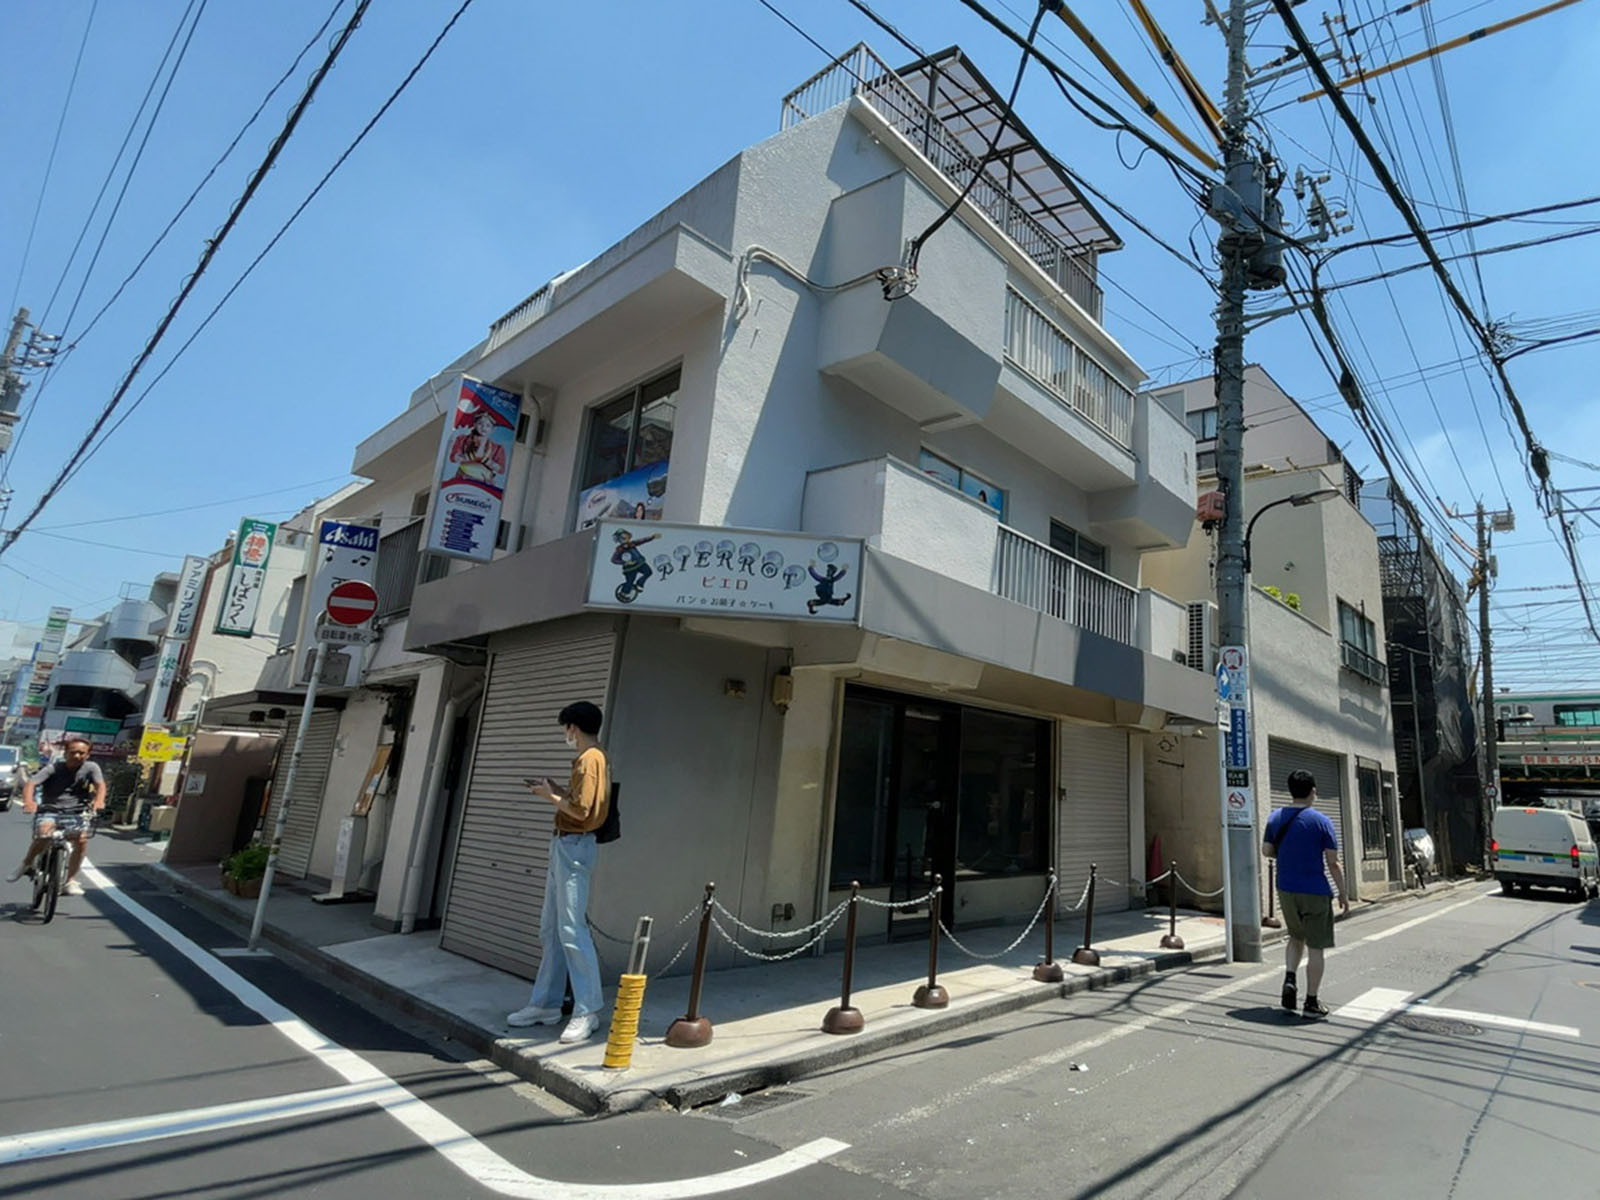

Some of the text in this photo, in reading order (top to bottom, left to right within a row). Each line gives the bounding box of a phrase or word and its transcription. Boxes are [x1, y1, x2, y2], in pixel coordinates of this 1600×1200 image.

[325, 526, 375, 549] Asahi
[657, 549, 798, 591] PIERROT
[702, 576, 748, 591] ピエロ
